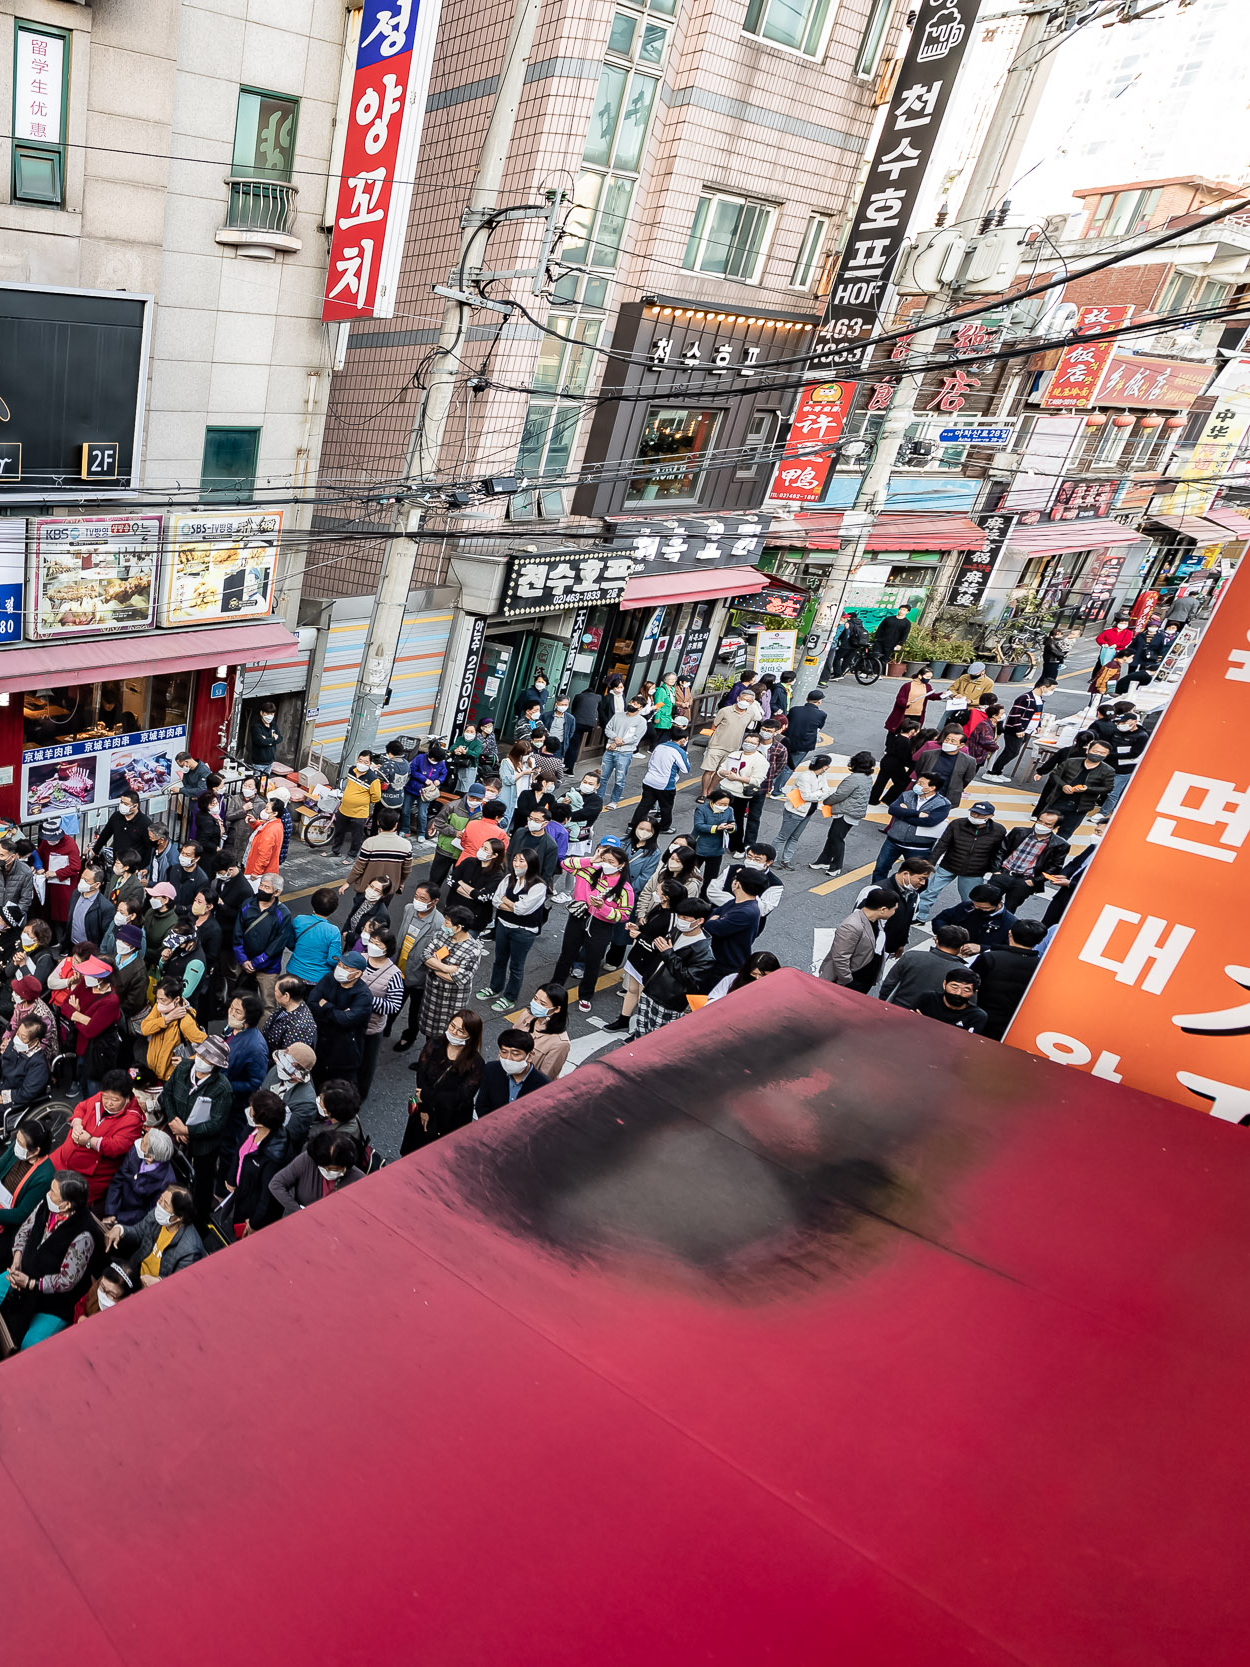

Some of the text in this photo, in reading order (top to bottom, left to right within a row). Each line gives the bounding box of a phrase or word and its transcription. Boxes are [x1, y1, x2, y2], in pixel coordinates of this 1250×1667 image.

[30, 39, 49, 138] 留学生优惠
[843, 80, 944, 279] 천수호프
[834, 281, 882, 305] HOF
[91, 449, 114, 472] 2F
[517, 559, 633, 598] 천수호프
[553, 590, 600, 604] 02)463-1833
[470, 620, 485, 651] 안주
[24, 726, 183, 763] 京城羊肉串 京城羊肉串 京城羊肉串
